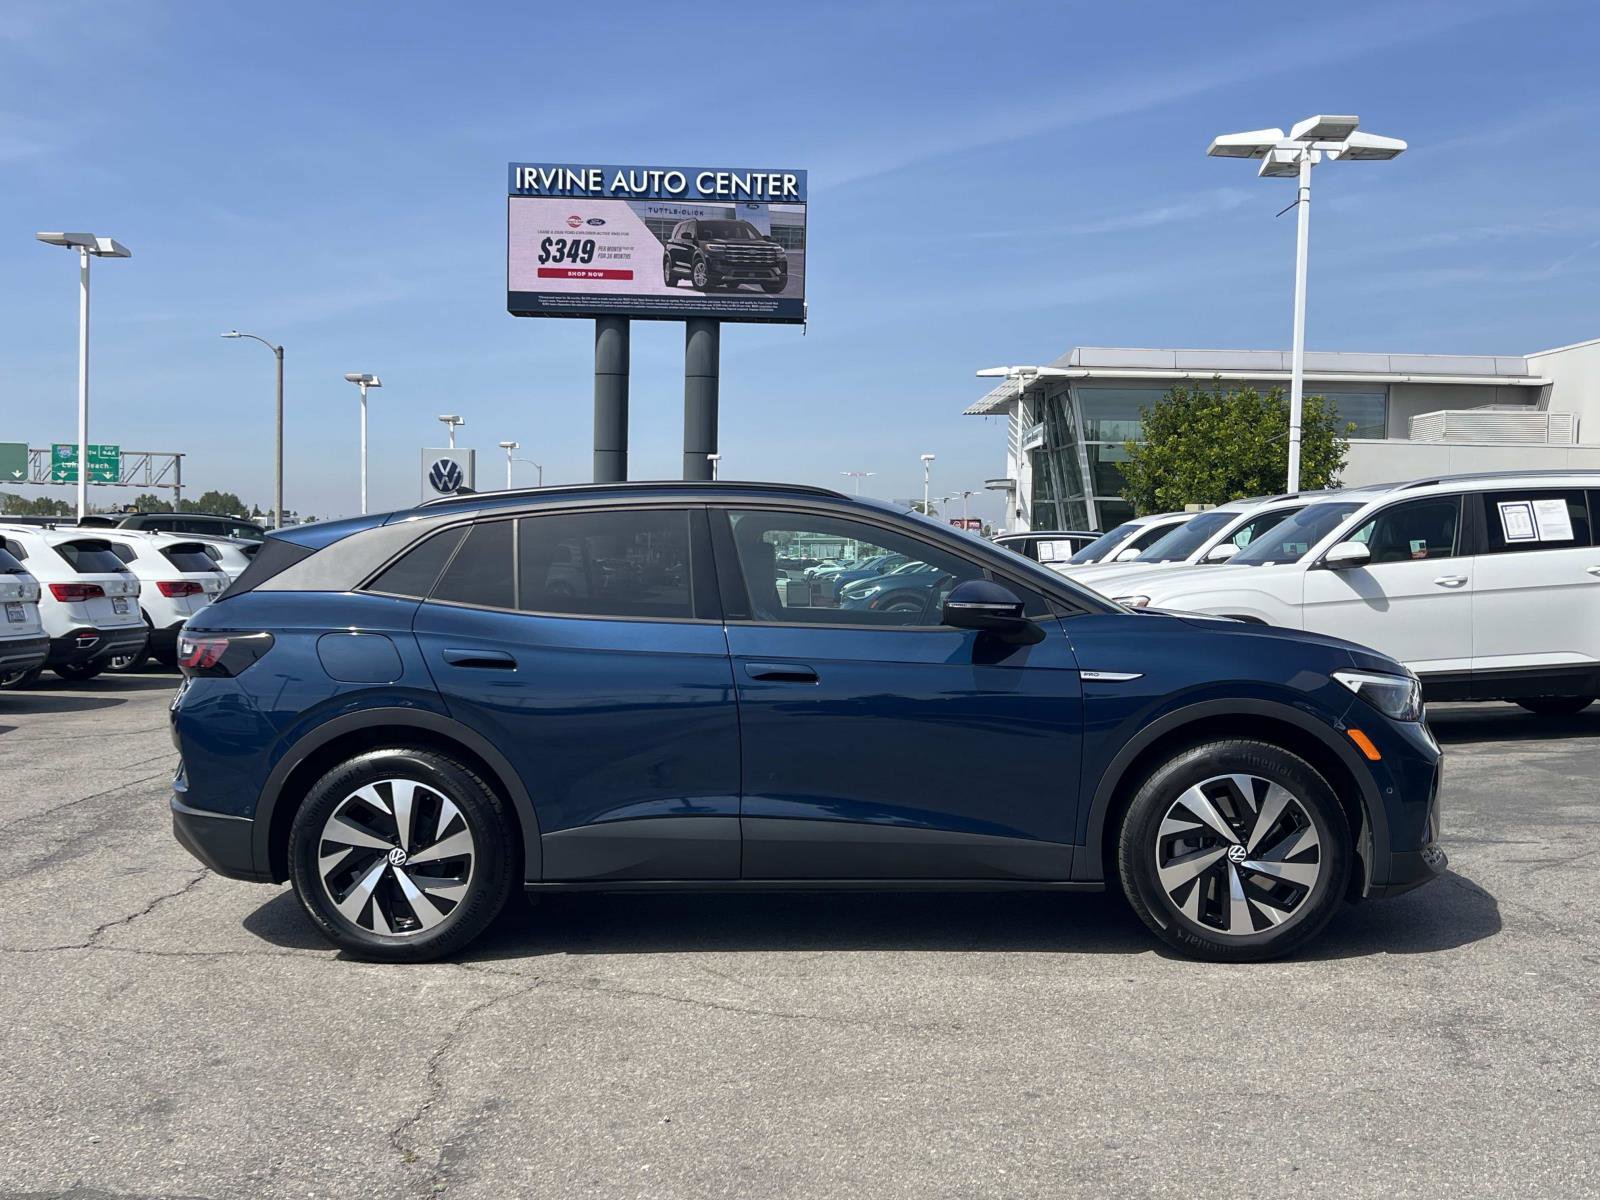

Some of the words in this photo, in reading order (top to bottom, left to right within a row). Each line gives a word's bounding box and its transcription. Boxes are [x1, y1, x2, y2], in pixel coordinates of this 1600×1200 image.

[515, 167, 602, 191] IRVINE
[611, 170, 686, 193] AUTO
[696, 172, 798, 196] CENTER
[538, 236, 596, 265] $349
